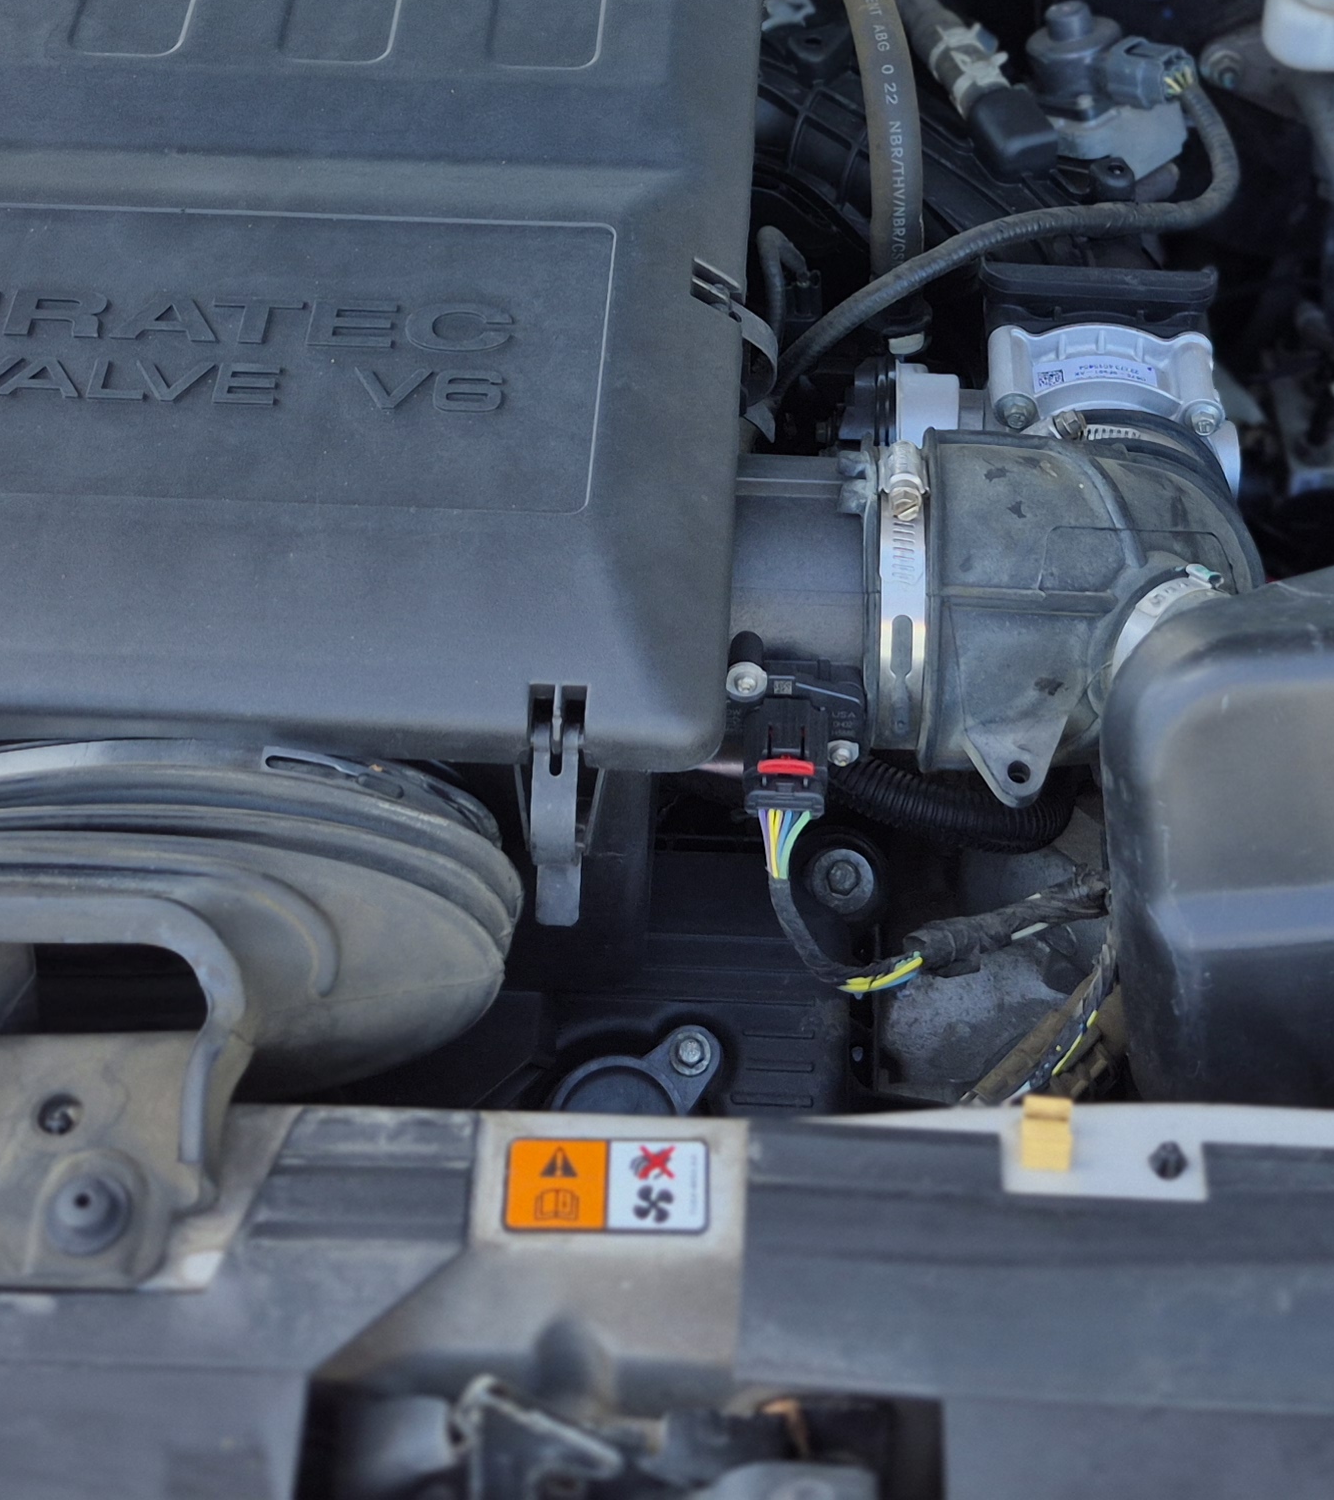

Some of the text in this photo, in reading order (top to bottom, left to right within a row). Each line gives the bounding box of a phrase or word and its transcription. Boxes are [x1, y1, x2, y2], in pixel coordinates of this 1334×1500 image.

[873, 24, 890, 51] ABG
[884, 82, 898, 106] 22
[354, 367, 510, 414] V6
